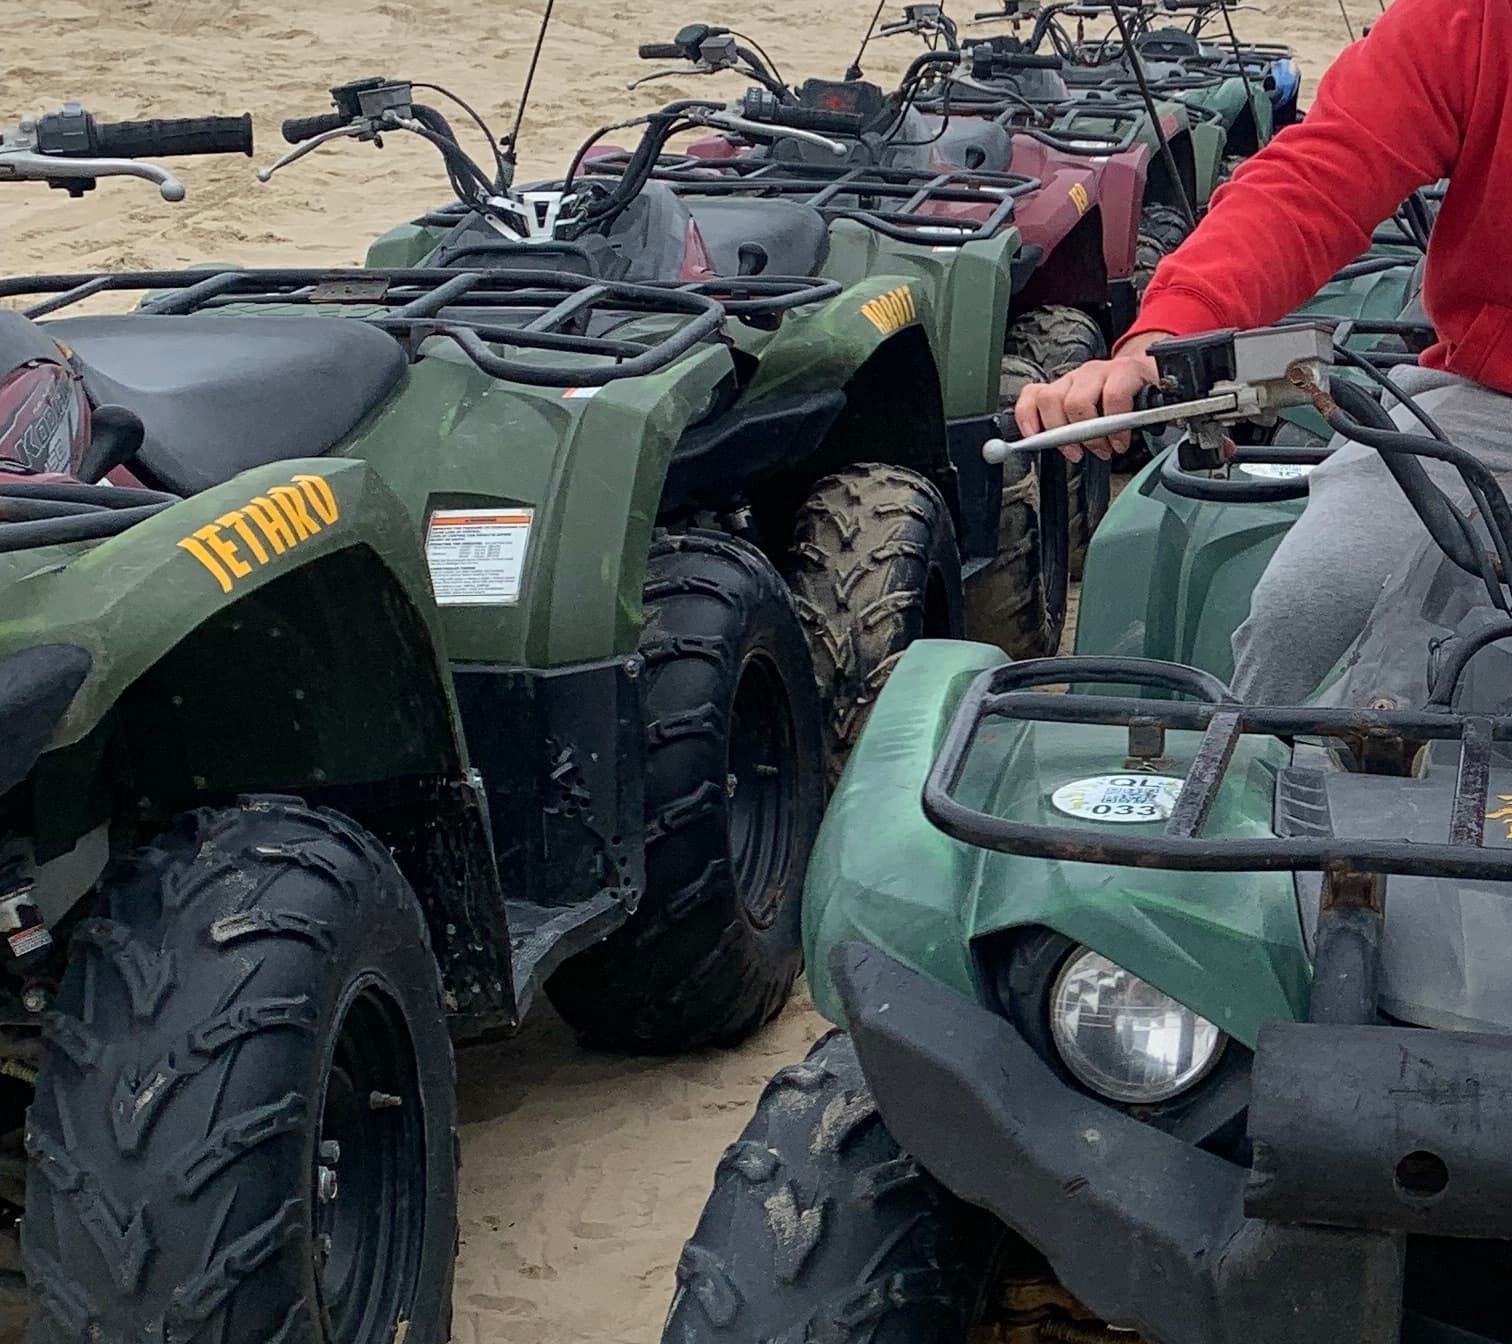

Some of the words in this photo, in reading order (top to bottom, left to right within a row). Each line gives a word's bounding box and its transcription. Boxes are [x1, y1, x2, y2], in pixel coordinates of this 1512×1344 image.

[176, 474, 339, 593] JETHRO
[1109, 777, 1161, 788] QL
[1092, 804, 1156, 816] 033
